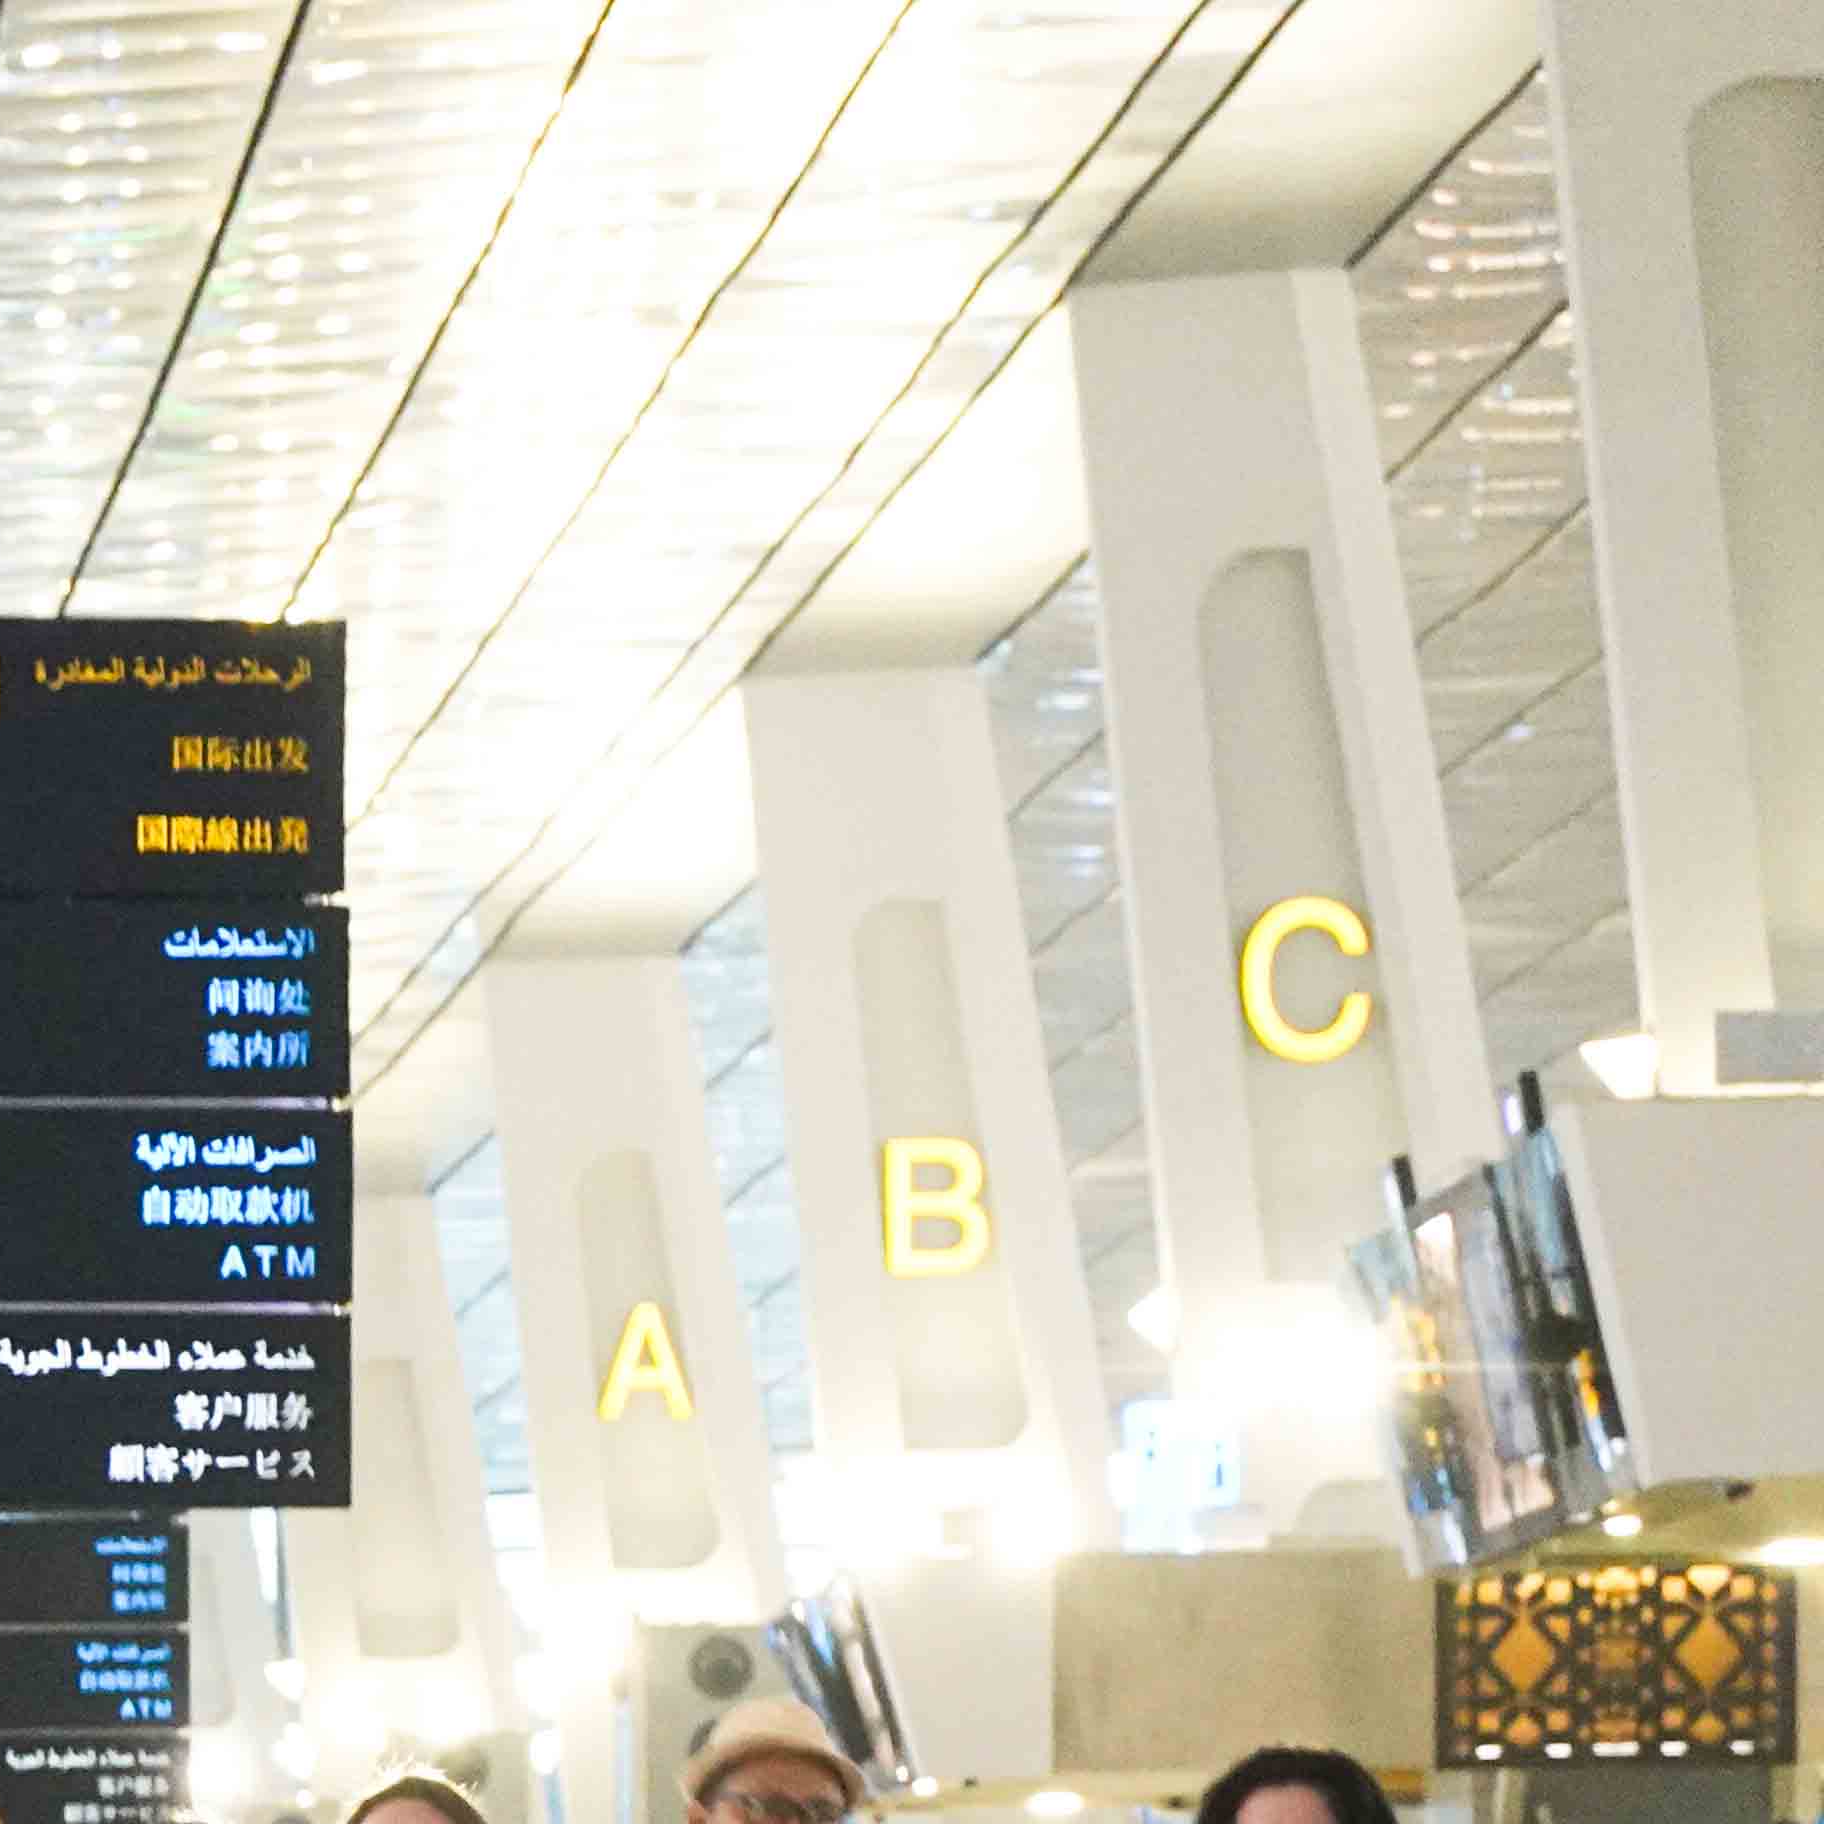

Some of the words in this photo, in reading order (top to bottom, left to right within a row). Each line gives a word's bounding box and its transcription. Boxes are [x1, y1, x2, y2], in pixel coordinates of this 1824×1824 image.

[173, 736, 307, 771] 国际出发
[1238, 897, 1373, 1063] C
[881, 1136, 992, 1277] B
[597, 1301, 693, 1421] A
